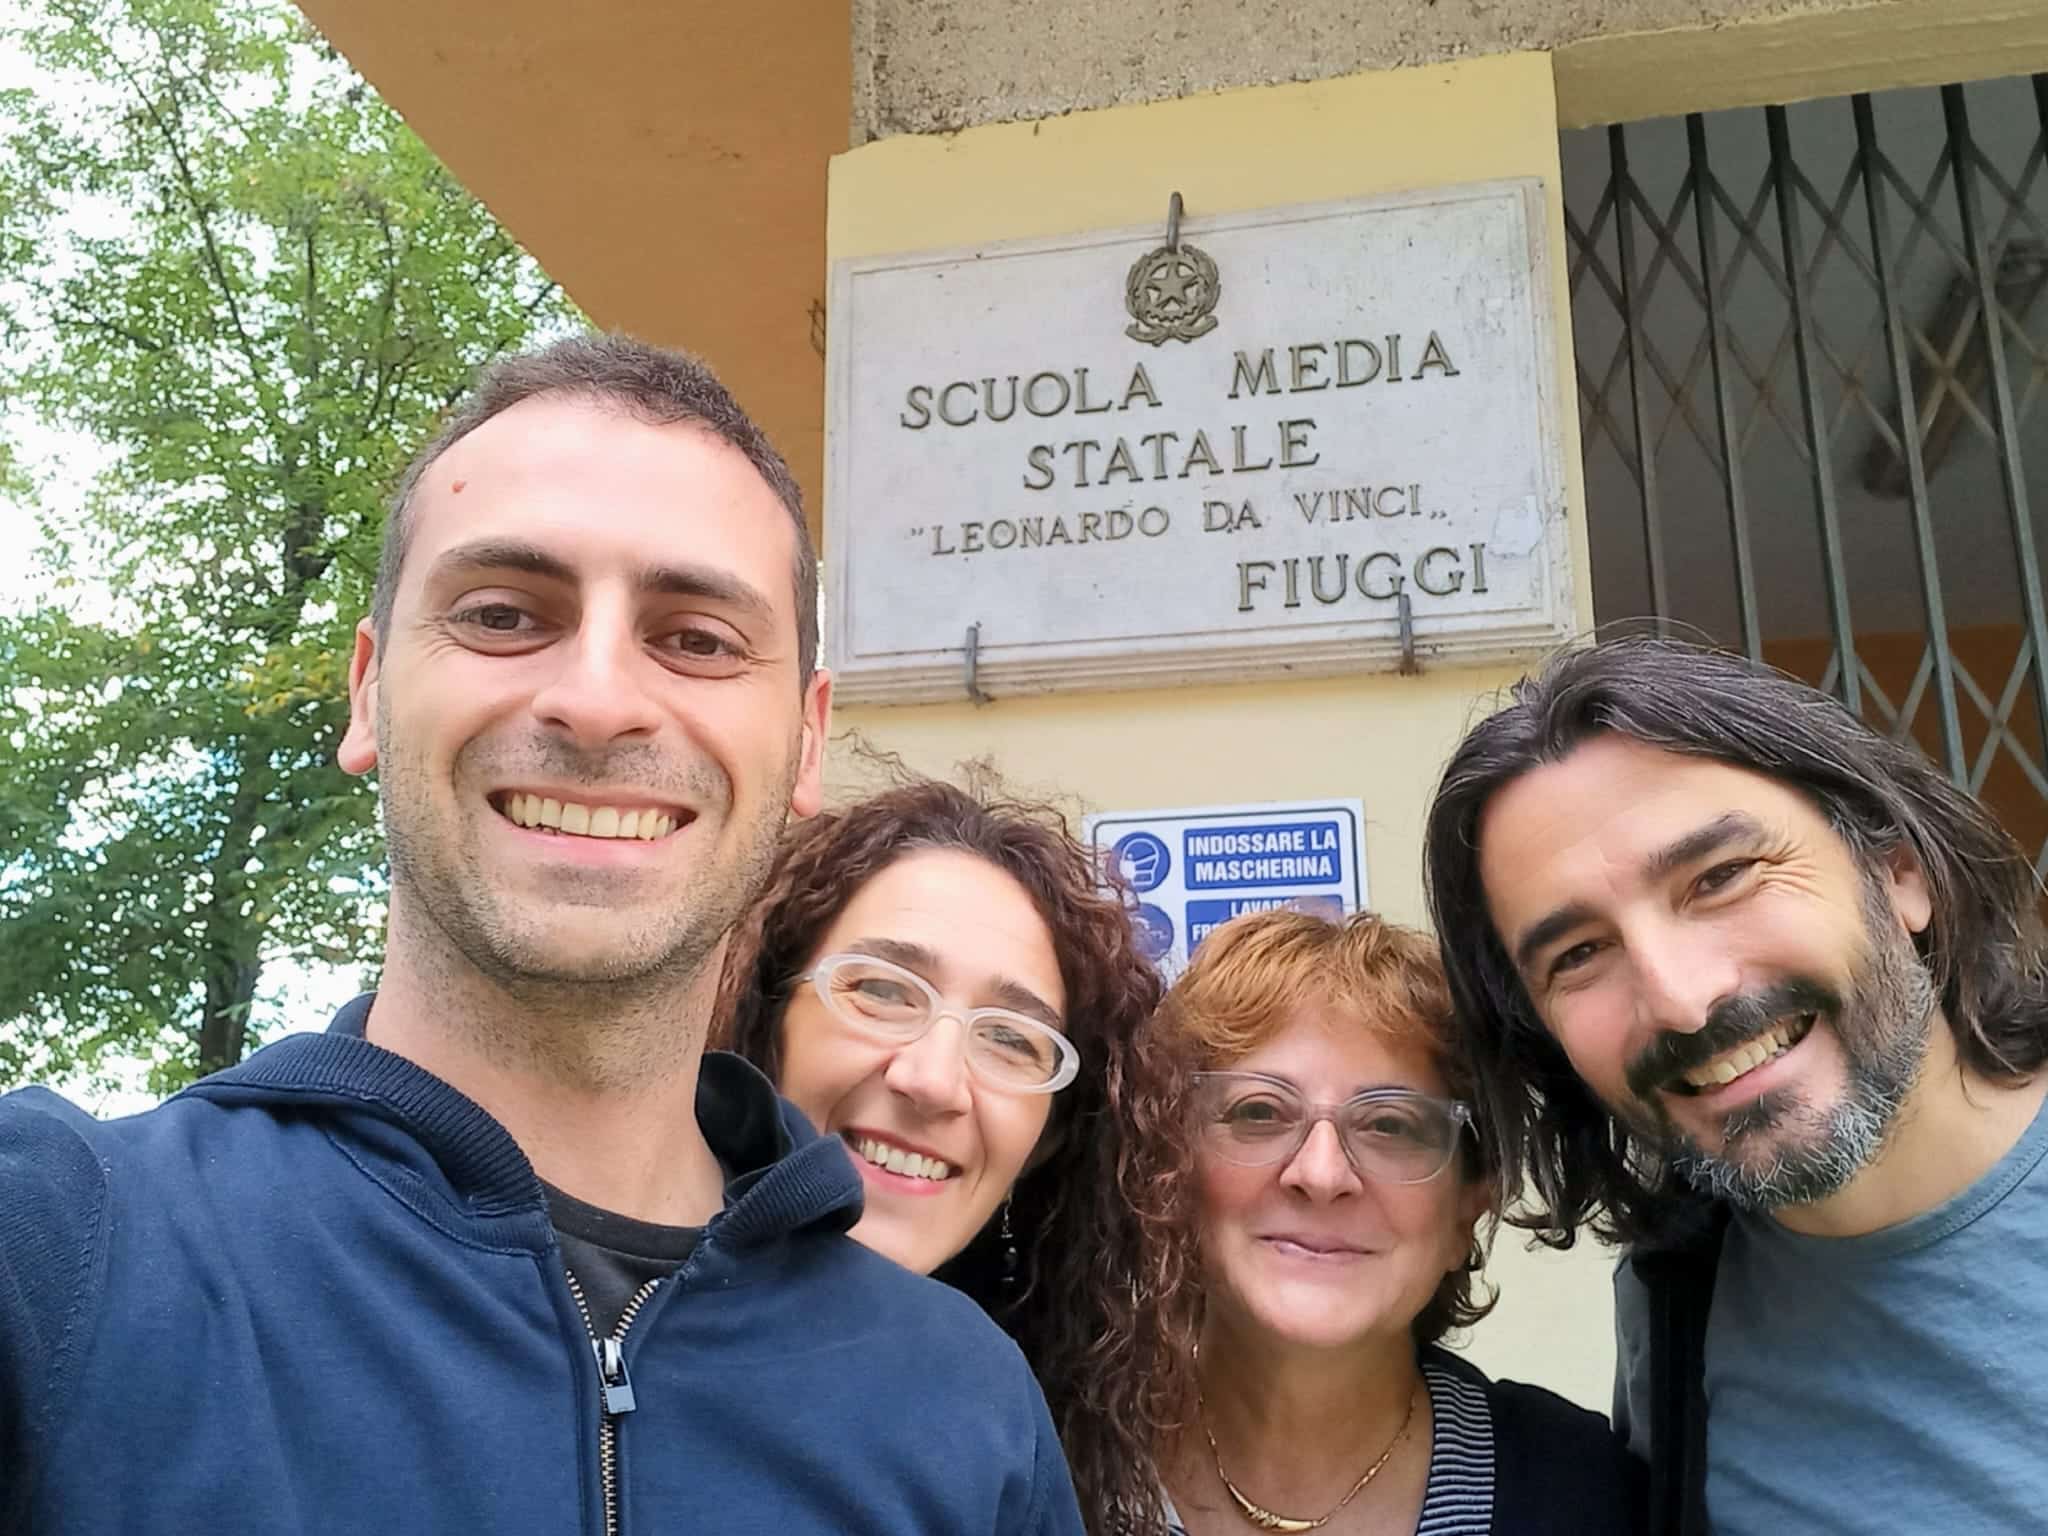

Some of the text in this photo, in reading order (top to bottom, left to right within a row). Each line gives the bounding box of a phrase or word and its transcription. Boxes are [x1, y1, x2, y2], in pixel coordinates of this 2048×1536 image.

[900, 330, 1461, 430] SCUOLA MEDIA
[1023, 418, 1321, 491] STATALE
[1236, 543, 1489, 612] FIUGGI
[1188, 829, 1337, 857] INDOSSARE LA
[1195, 856, 1333, 882] MASCHERINA
